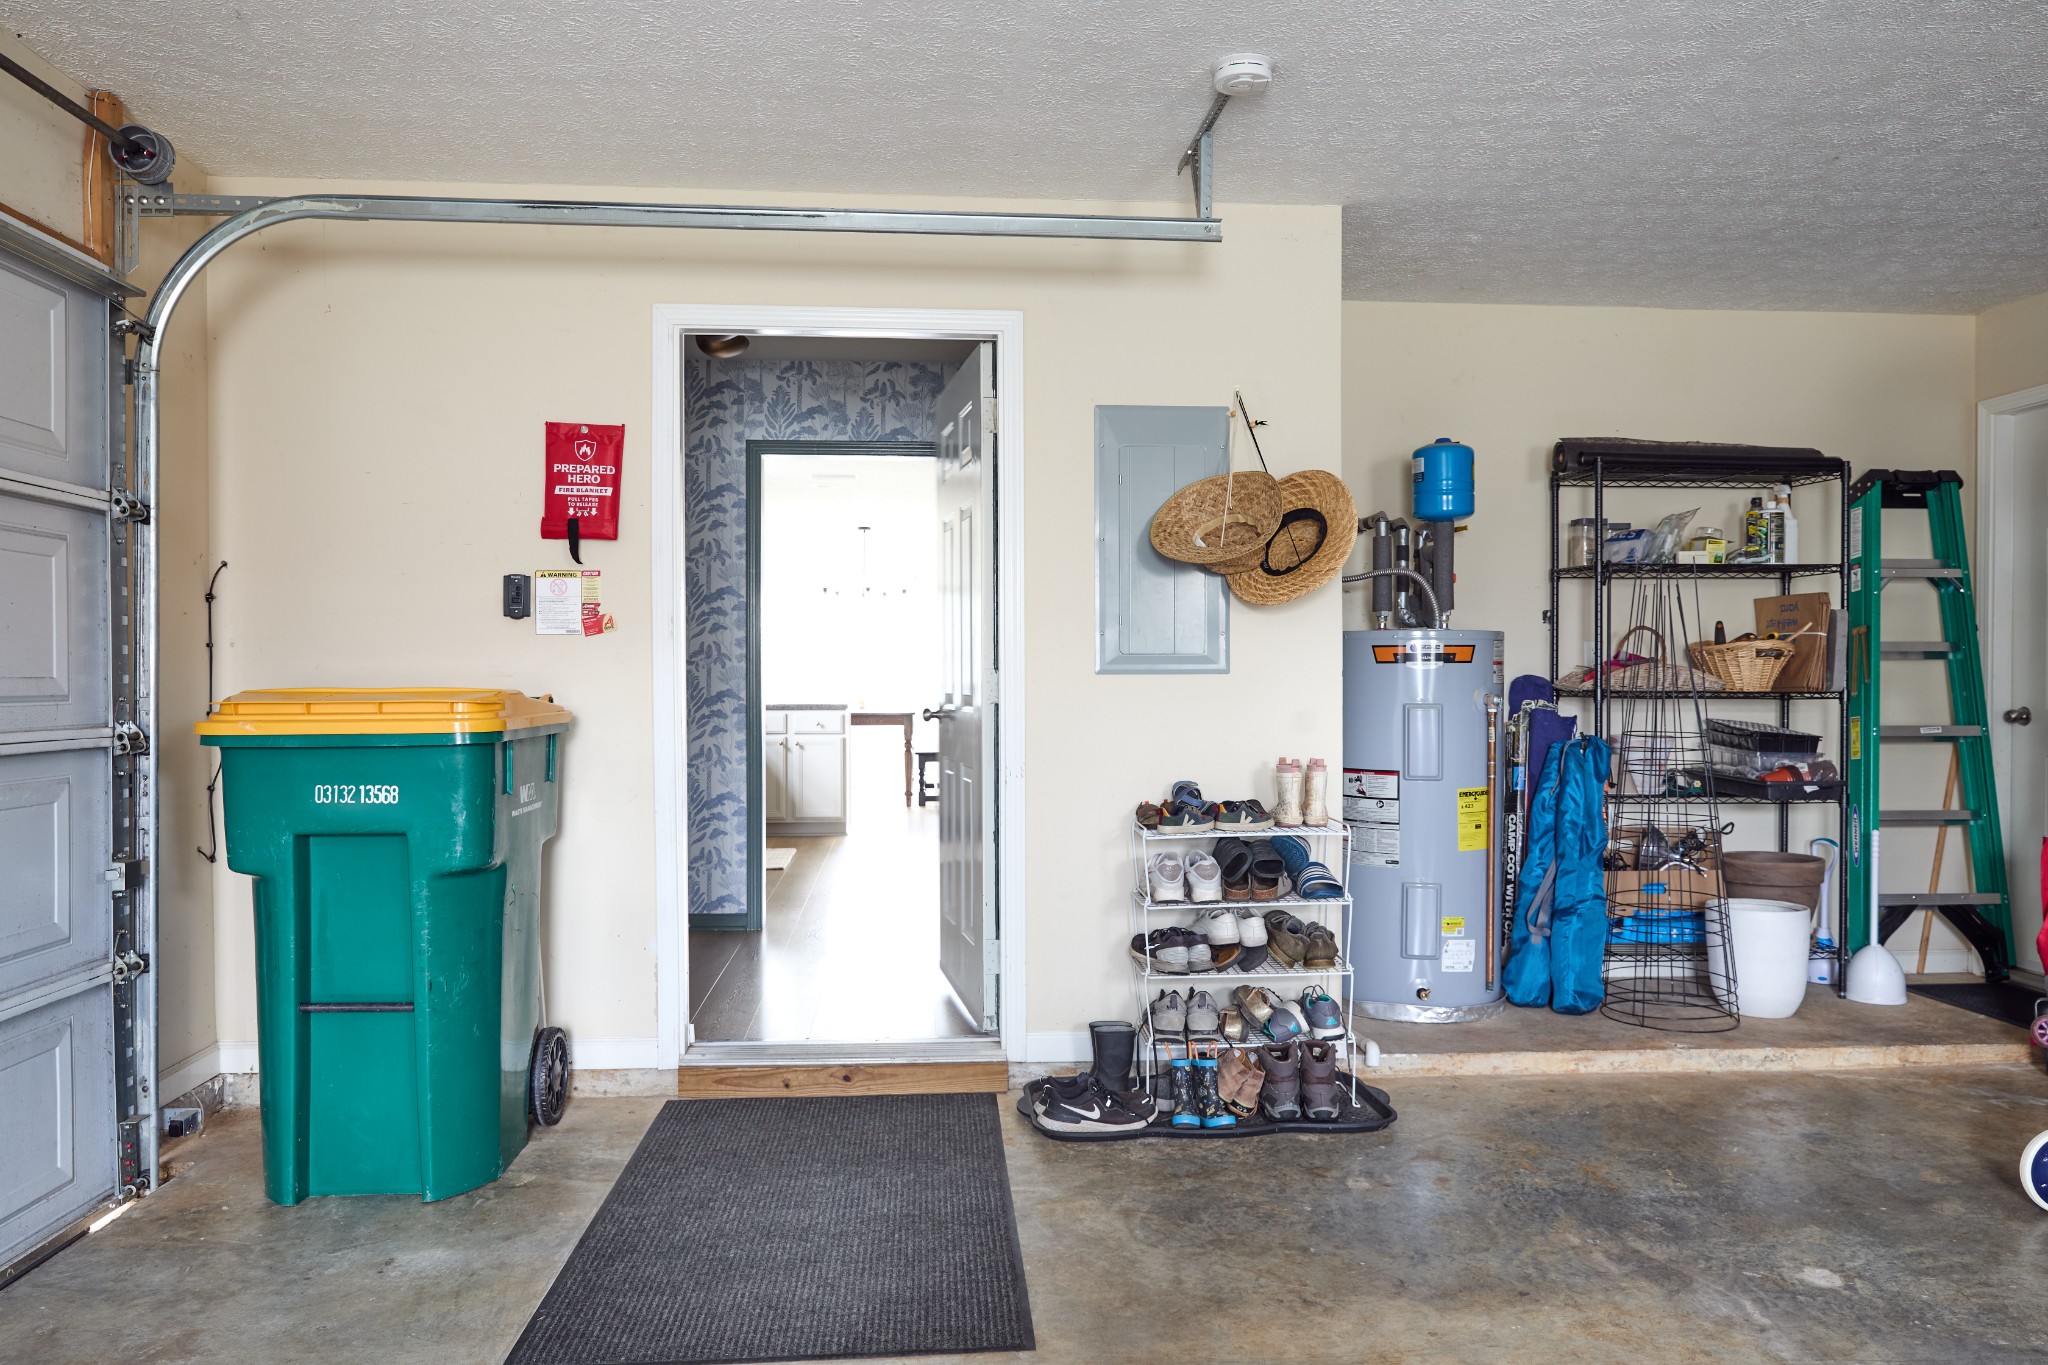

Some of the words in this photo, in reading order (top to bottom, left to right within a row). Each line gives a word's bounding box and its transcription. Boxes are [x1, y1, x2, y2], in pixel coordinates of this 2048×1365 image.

[553, 463, 616, 475] PREPARED
[567, 474, 601, 484] HERO
[314, 784, 355, 804] 03132
[359, 784, 400, 805] 13568
[1508, 814, 1516, 853] CAMP
[1507, 854, 1516, 882] COT
[1505, 883, 1515, 918] WITH
